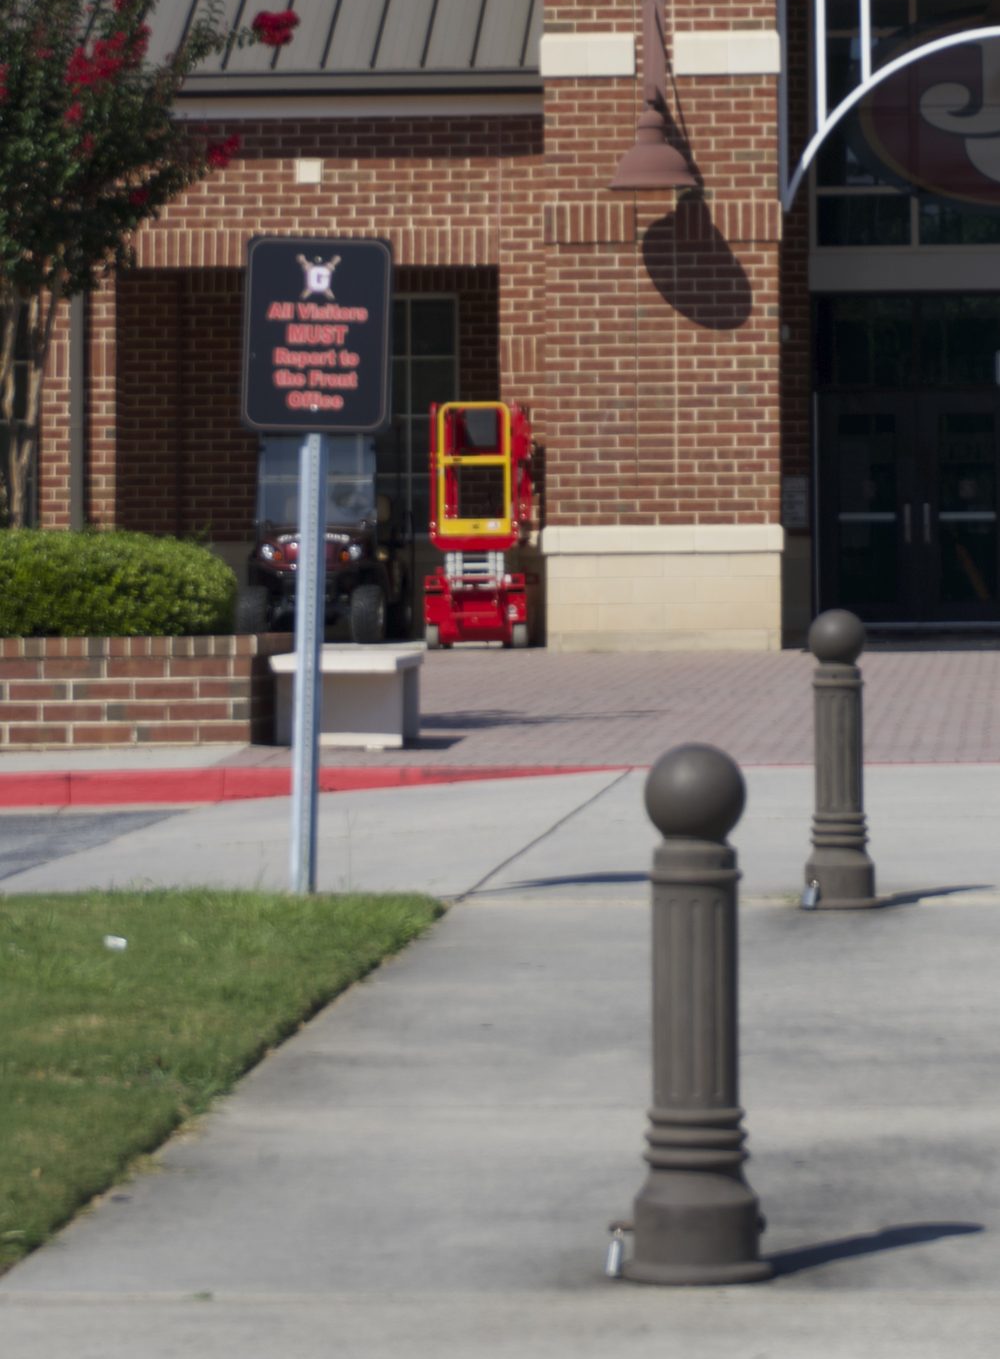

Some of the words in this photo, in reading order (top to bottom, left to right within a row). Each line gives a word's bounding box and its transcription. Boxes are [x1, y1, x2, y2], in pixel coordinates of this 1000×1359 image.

[267, 302, 295, 321] All
[297, 301, 368, 322] Visitors
[286, 323, 349, 344] MUST
[273, 347, 337, 369] Report
[338, 350, 360, 367] to
[273, 369, 306, 387] the
[308, 369, 358, 389] Front
[286, 391, 344, 411] Office
